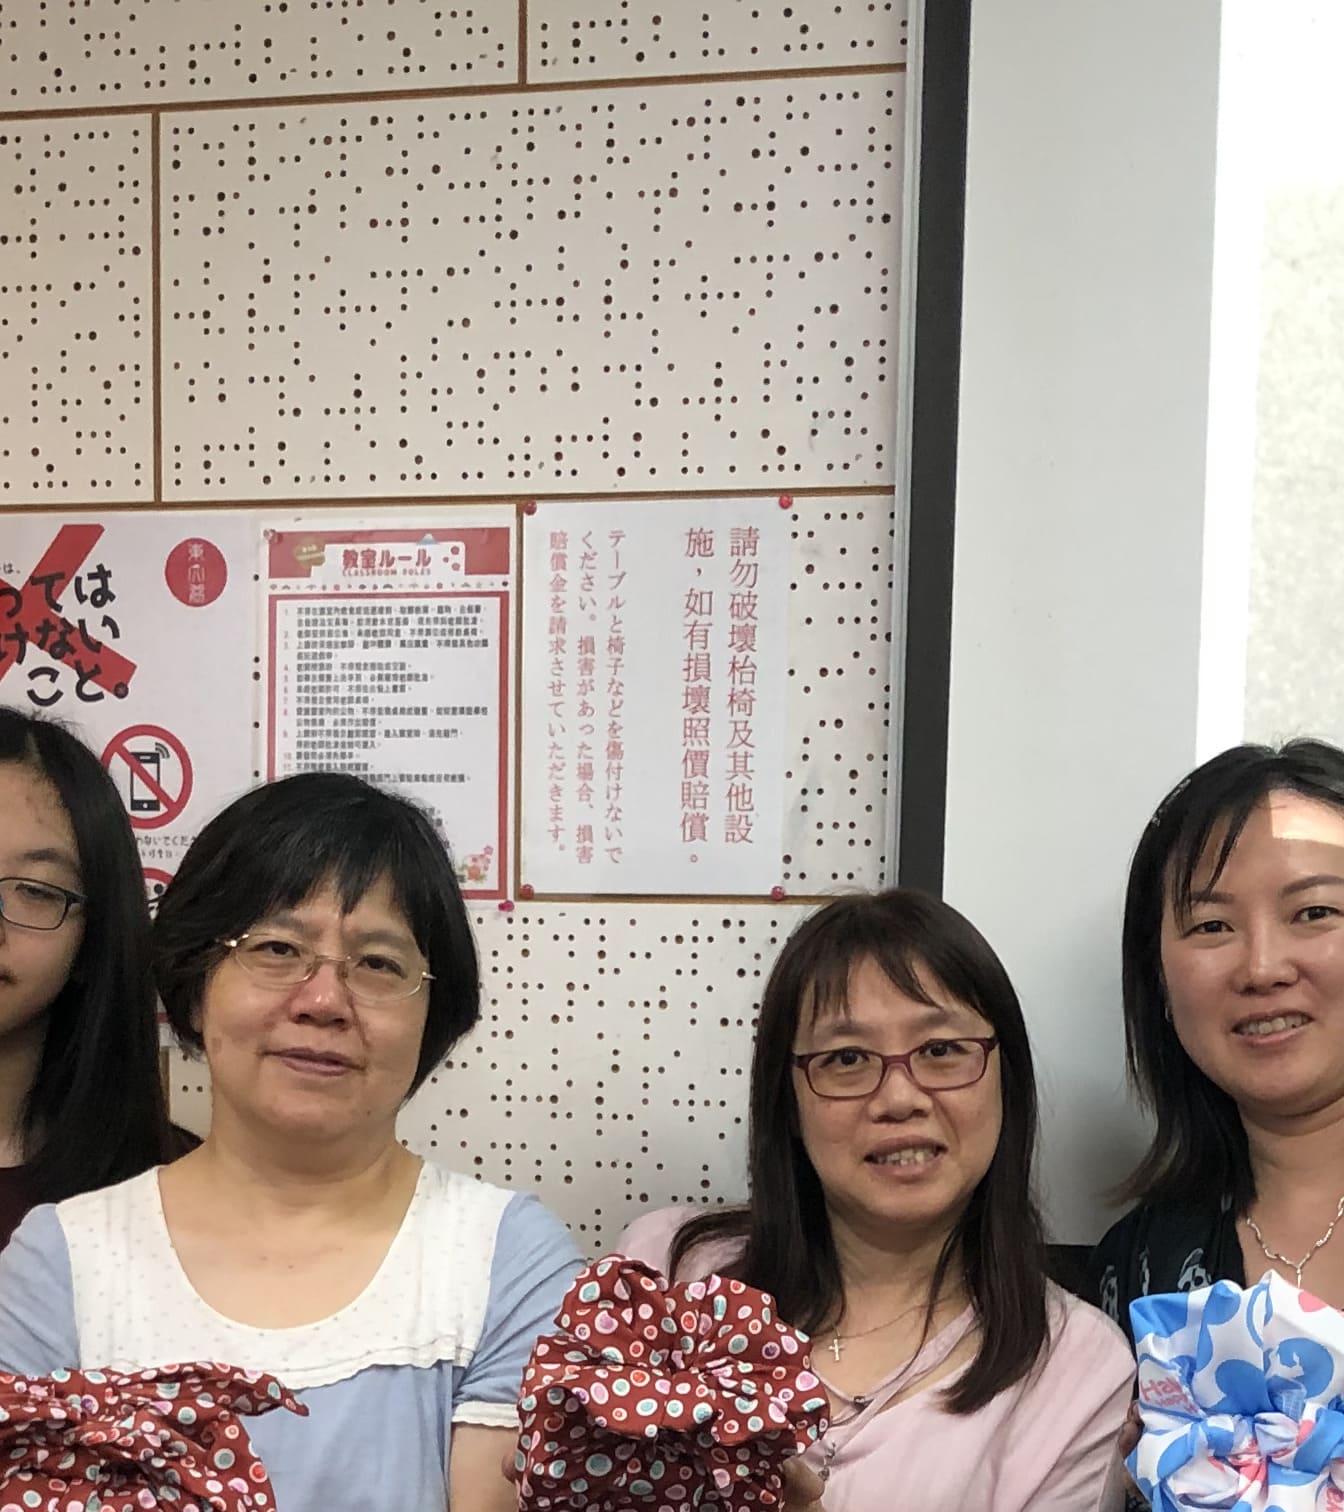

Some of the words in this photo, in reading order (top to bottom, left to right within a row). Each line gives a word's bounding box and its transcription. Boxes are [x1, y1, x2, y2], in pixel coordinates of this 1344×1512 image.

[342, 548, 432, 569] 教室ルール
[27, 660, 129, 706] こと。
[724, 525, 761, 844] 請勿破壞枱椅及其他設
